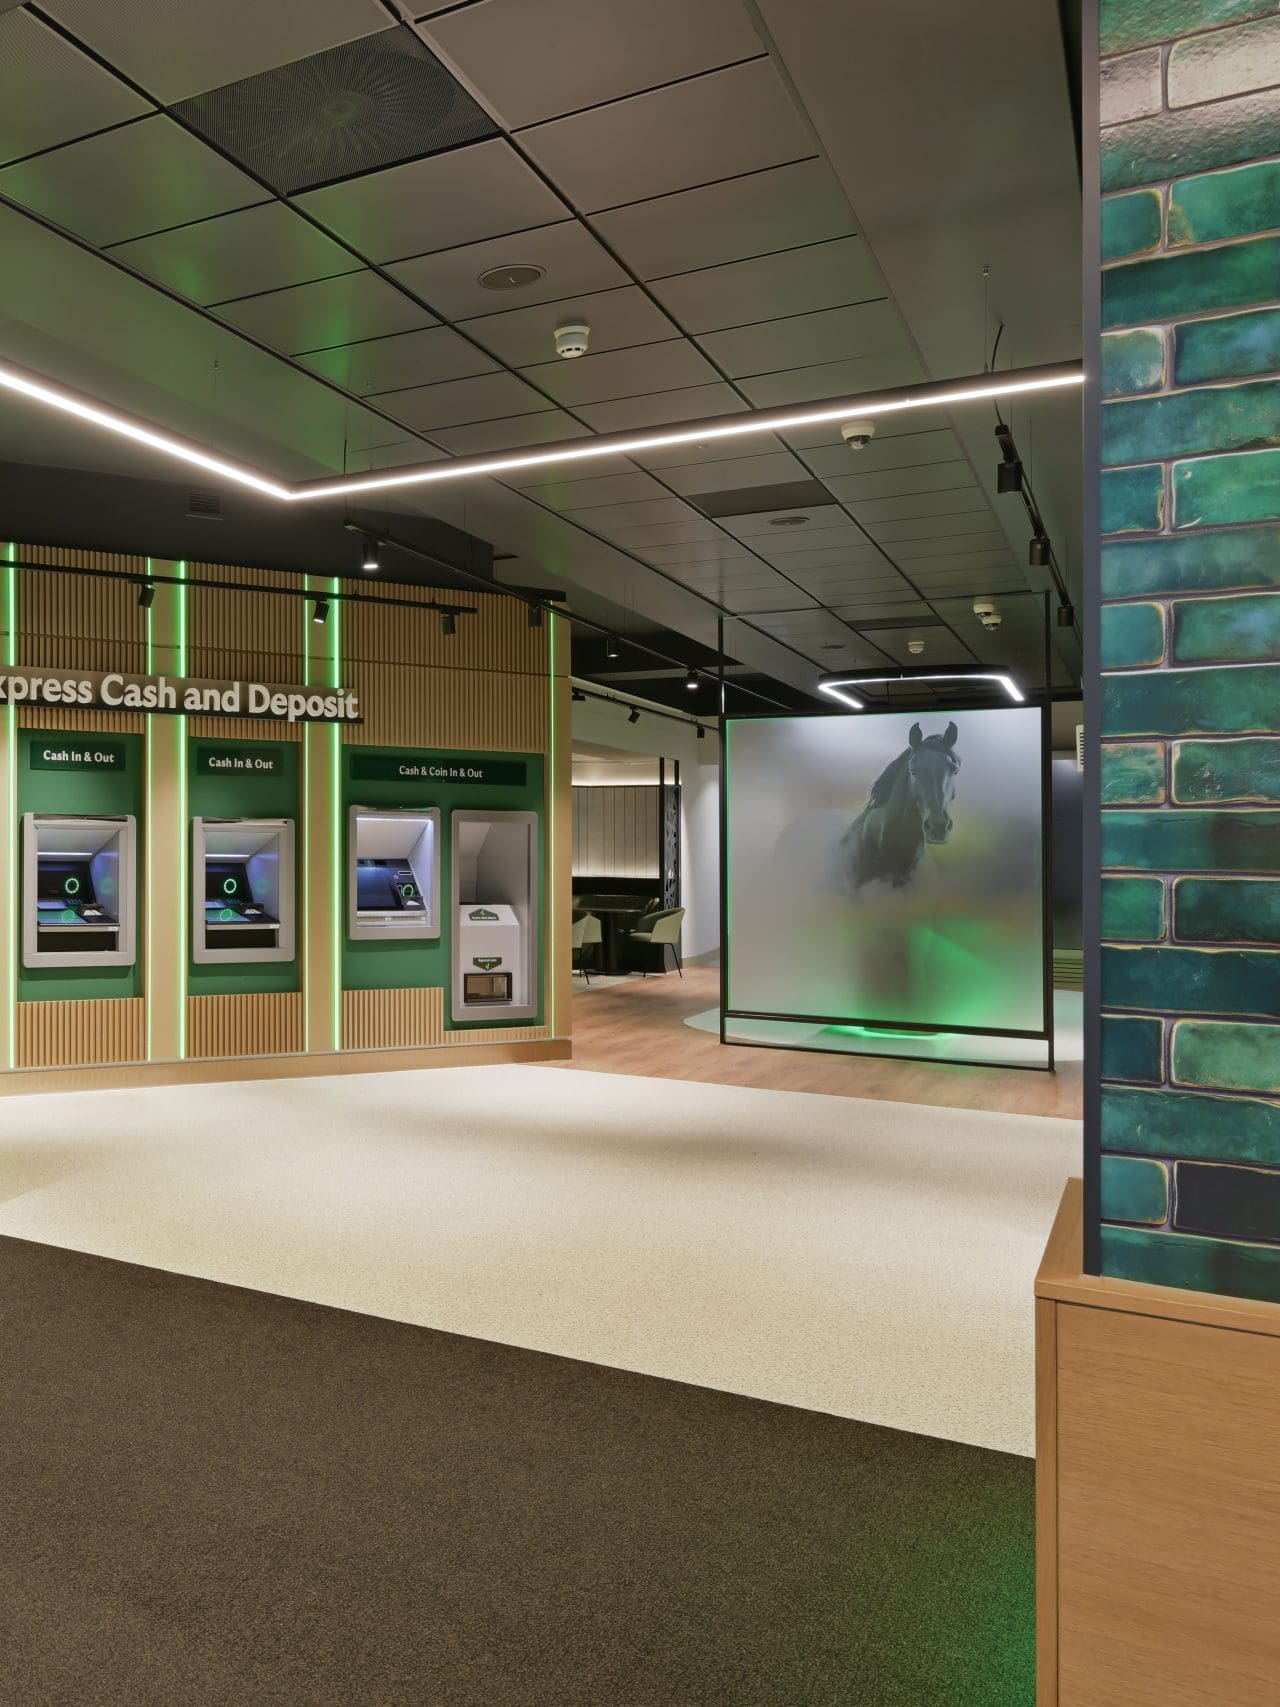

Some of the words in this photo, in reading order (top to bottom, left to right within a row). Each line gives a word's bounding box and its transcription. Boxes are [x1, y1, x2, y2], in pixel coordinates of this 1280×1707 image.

[100, 674, 176, 709] Cash
[184, 682, 240, 713] and
[248, 684, 359, 722] Deposit
[43, 750, 69, 761] Cash
[71, 751, 82, 762] In
[83, 752, 92, 762] &
[94, 752, 114, 763] Out
[208, 757, 232, 768] Cash
[234, 758, 243, 768] In
[245, 759, 253, 769] &
[255, 759, 273, 769] Out
[399, 765, 419, 776] Cash
[421, 766, 427, 776] &
[429, 766, 448, 777] Coin
[449, 768, 458, 777] In
[459, 768, 466, 777] &
[467, 768, 483, 778] Out
